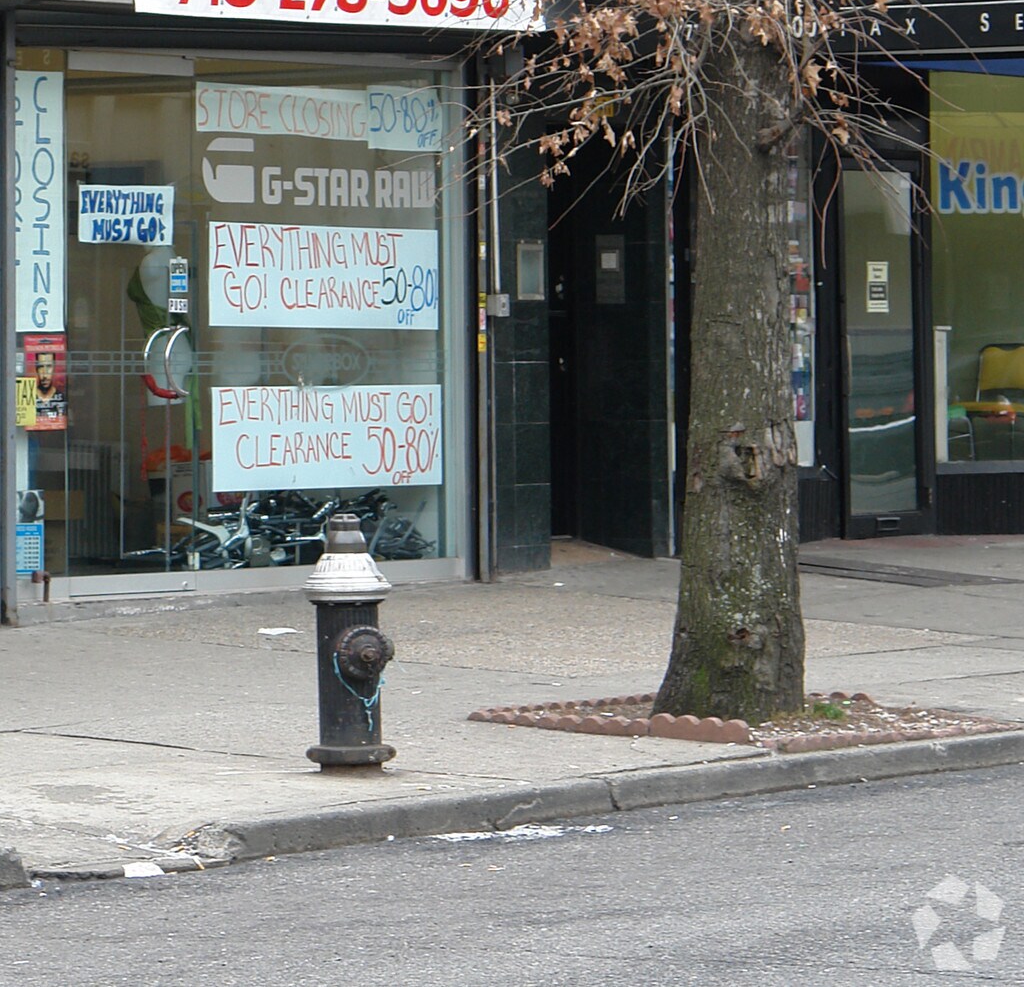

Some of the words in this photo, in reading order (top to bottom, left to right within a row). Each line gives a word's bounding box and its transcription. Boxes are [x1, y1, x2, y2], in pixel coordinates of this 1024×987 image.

[198, 88, 271, 130] STORE
[278, 94, 366, 138] CLOSING
[32, 76, 55, 329] CLOSING
[81, 190, 164, 215] EVERYTHING
[261, 166, 369, 207] G-STAR
[375, 170, 435, 208] RAW
[938, 160, 1024, 212] Kin
[92, 217, 134, 242] MUST
[137, 217, 166, 242] GO!
[213, 224, 348, 271] EVERYTHING
[351, 231, 403, 269] MUST
[224, 271, 268, 313] GO!
[280, 277, 381, 310] CLEARANCE
[219, 388, 334, 426] EVERYTHING
[342, 391, 391, 423] MUST
[397, 391, 433, 427] GO!
[236, 432, 352, 469] CLEARANCE
[362, 425, 439, 474] 50-80%
